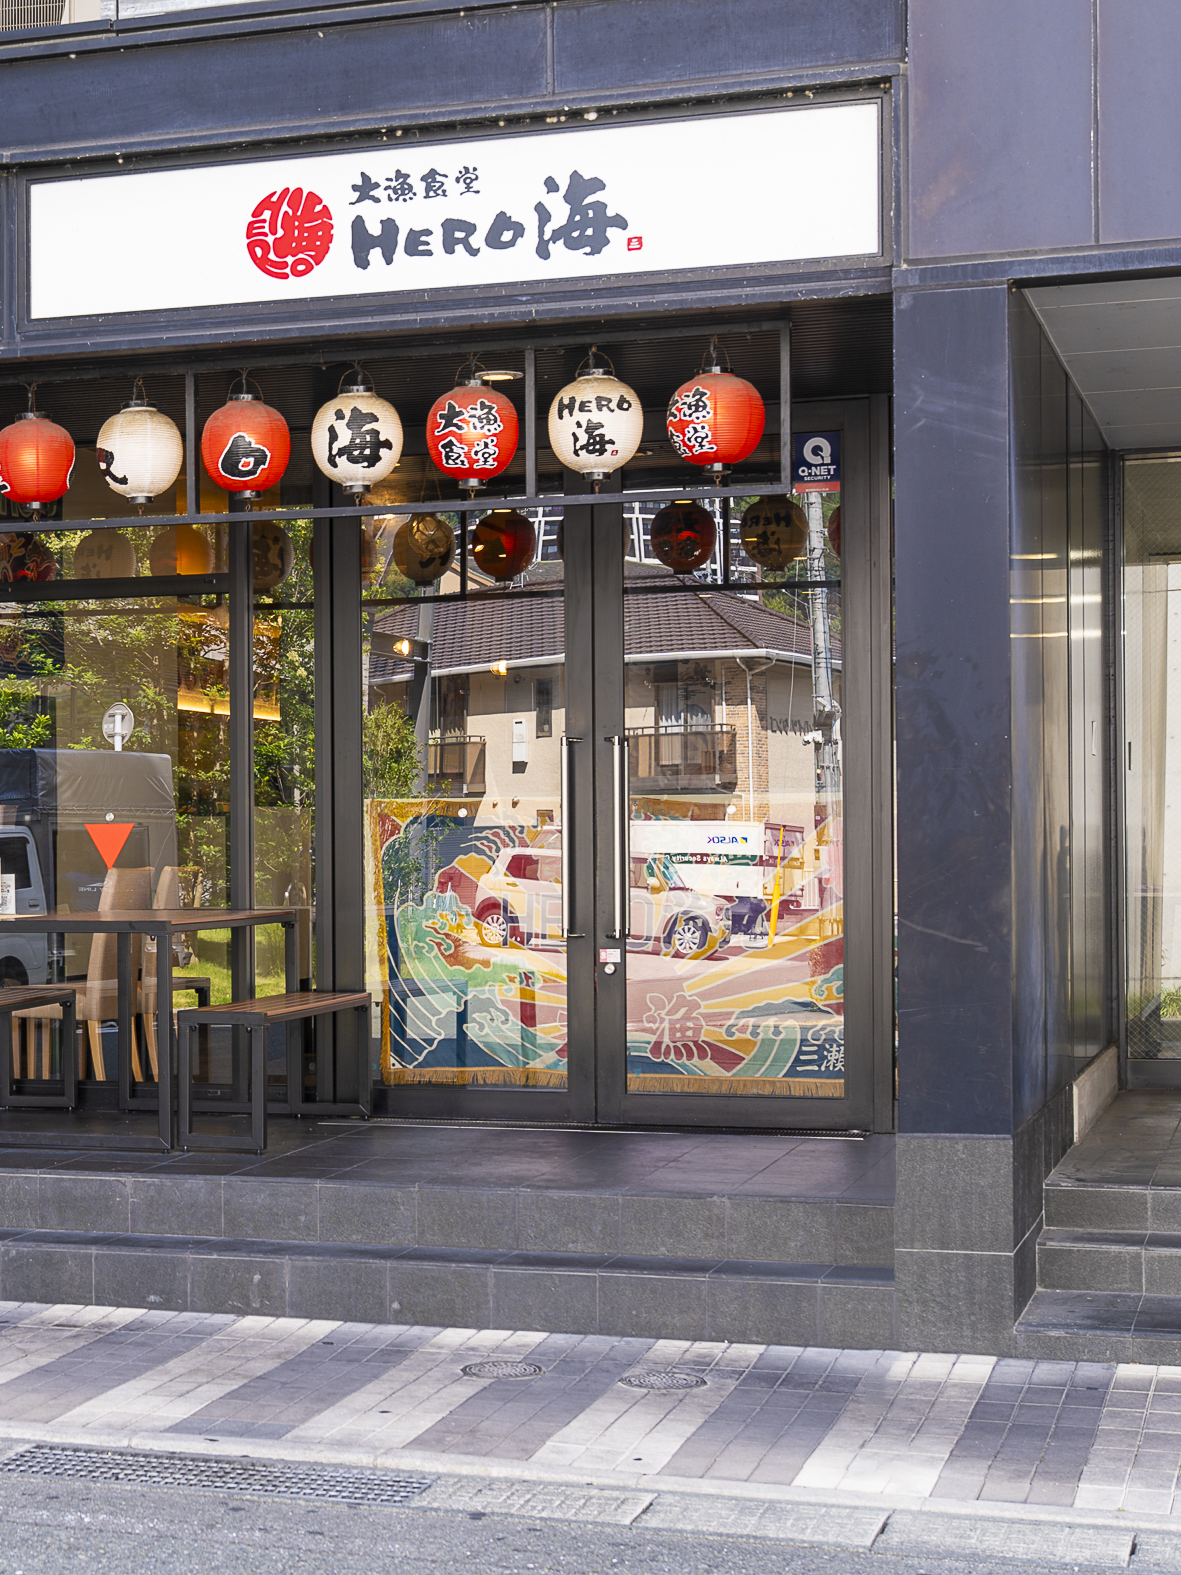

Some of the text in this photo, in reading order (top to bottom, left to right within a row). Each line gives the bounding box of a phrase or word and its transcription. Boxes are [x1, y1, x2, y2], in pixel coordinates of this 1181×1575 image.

[349, 166, 480, 205] 大漁食堂
[557, 395, 632, 420] HERO
[328, 406, 393, 469] 海
[572, 418, 616, 457] 海
